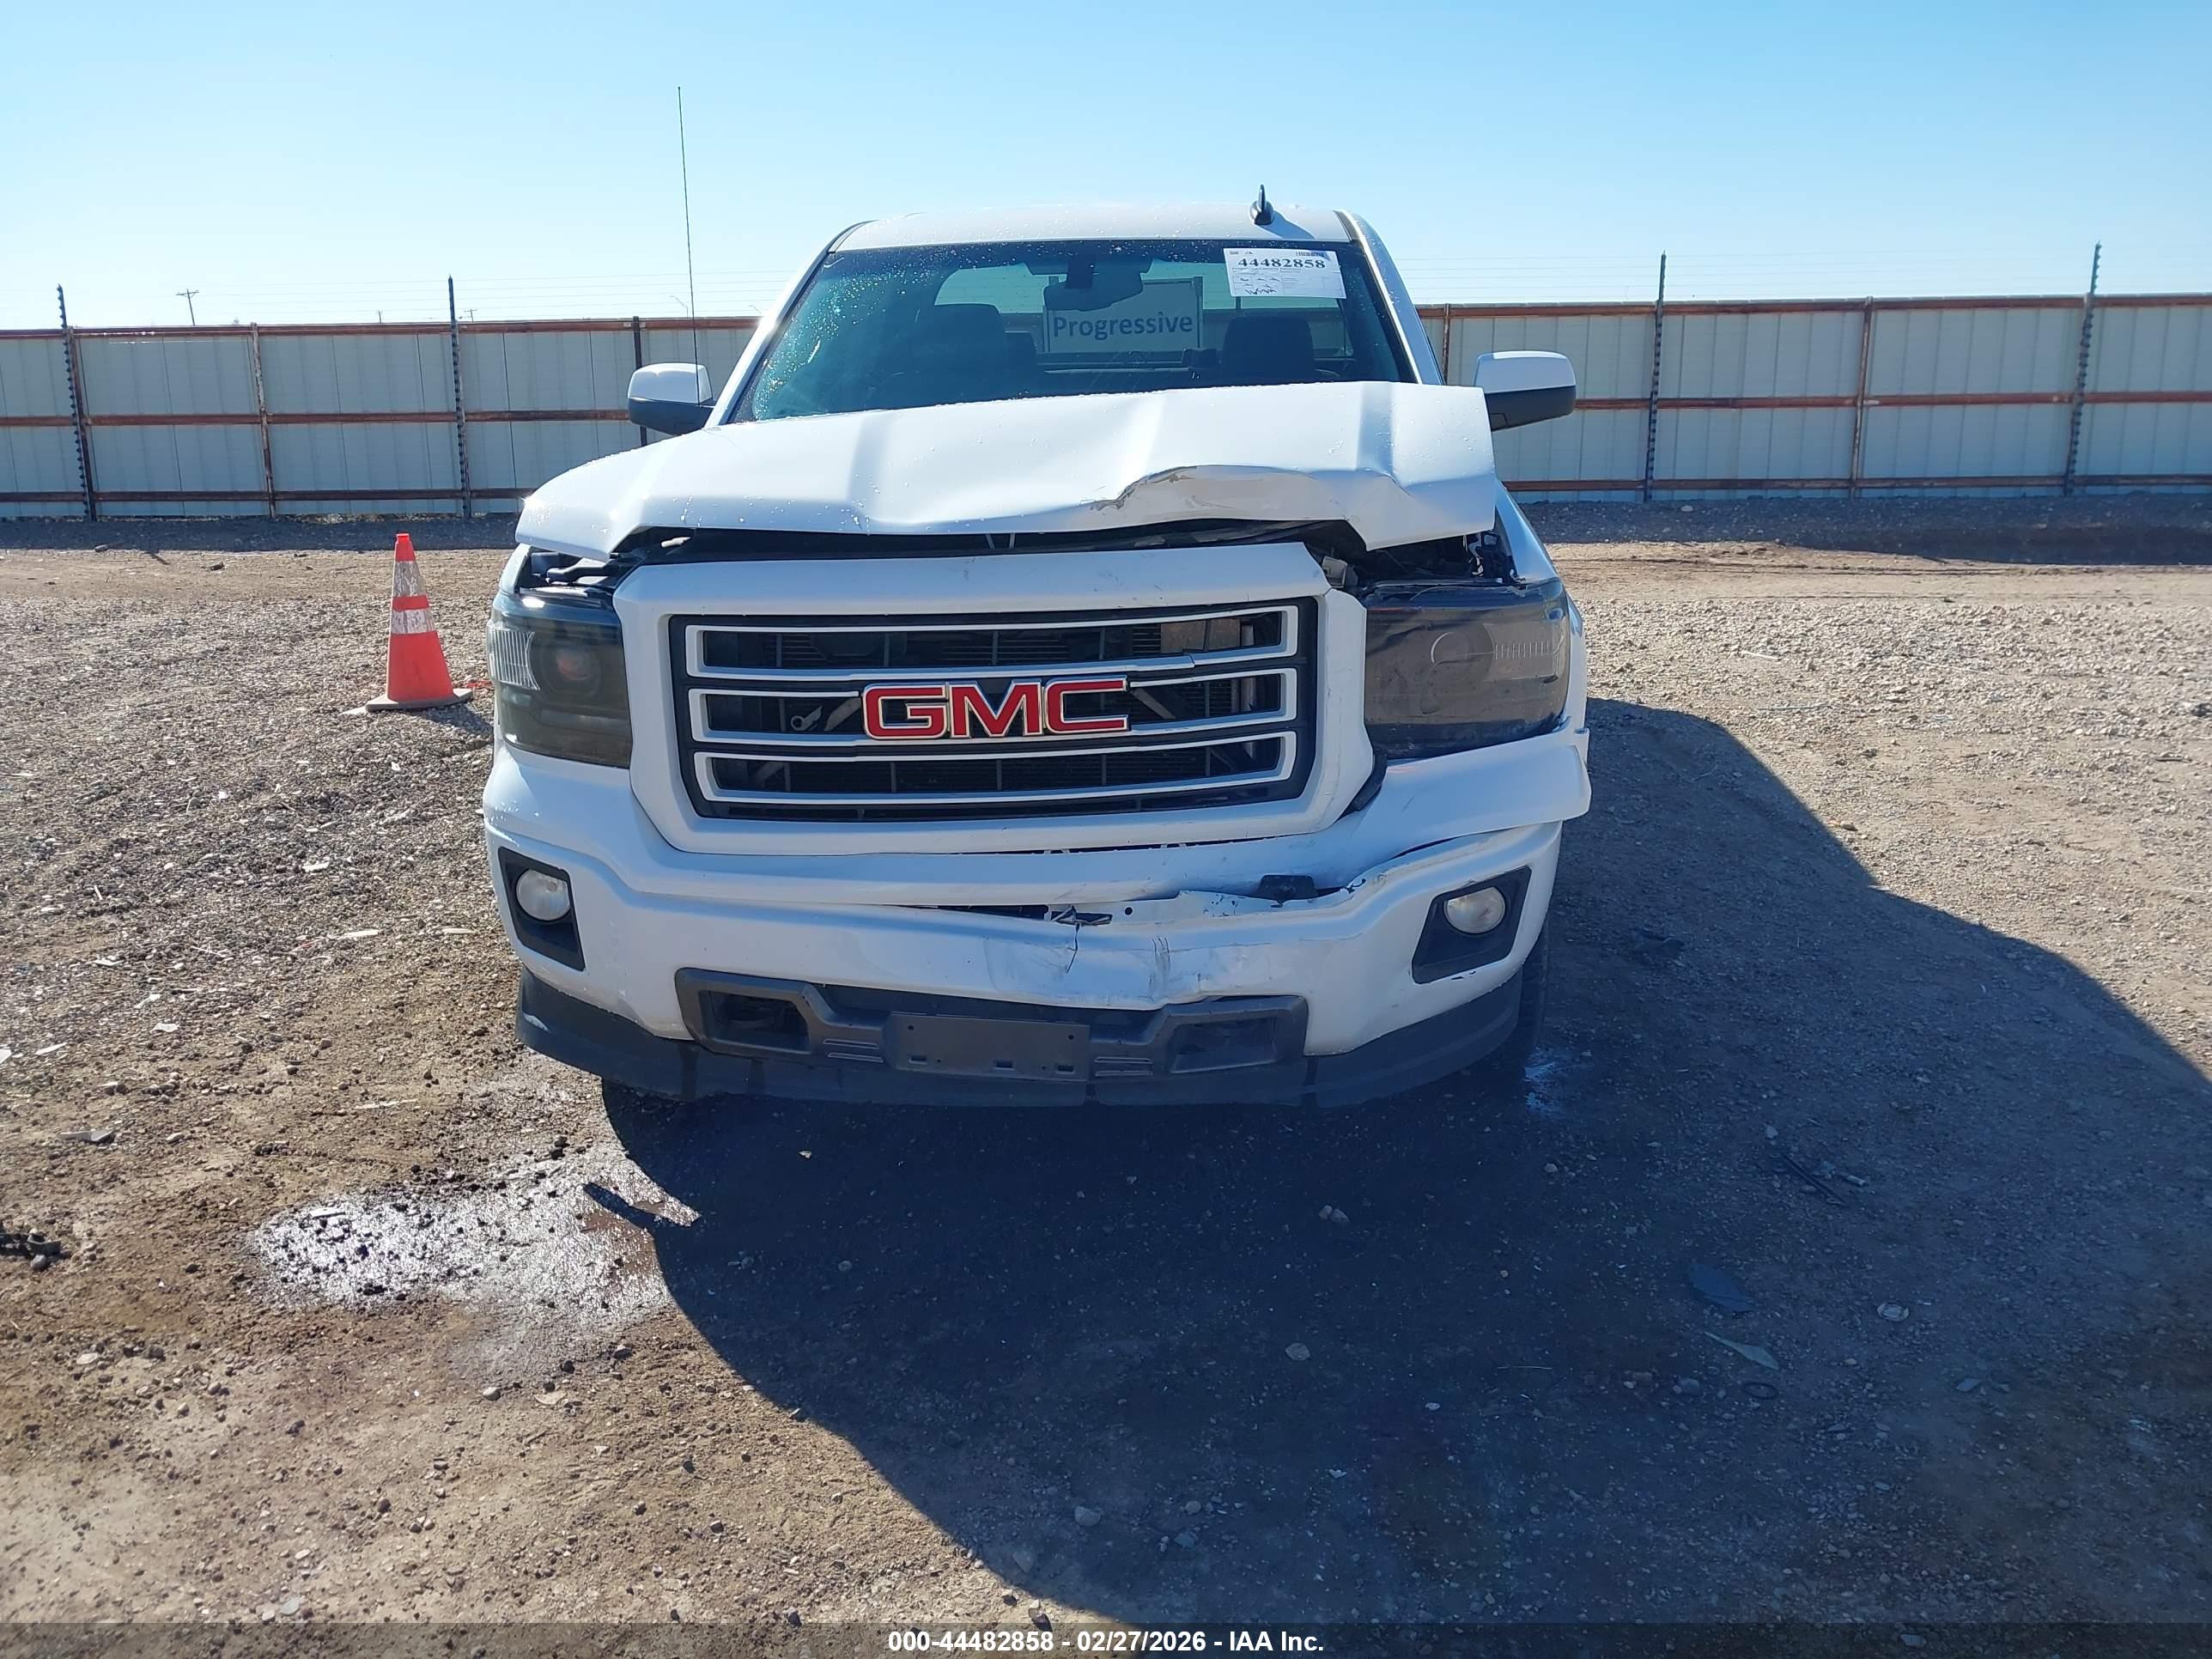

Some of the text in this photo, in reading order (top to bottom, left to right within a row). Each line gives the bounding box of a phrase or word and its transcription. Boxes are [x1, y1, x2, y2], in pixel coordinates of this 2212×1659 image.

[1238, 258, 1326, 269] 44482858
[1053, 311, 1194, 341] Progressive
[861, 675, 1129, 740] GMC
